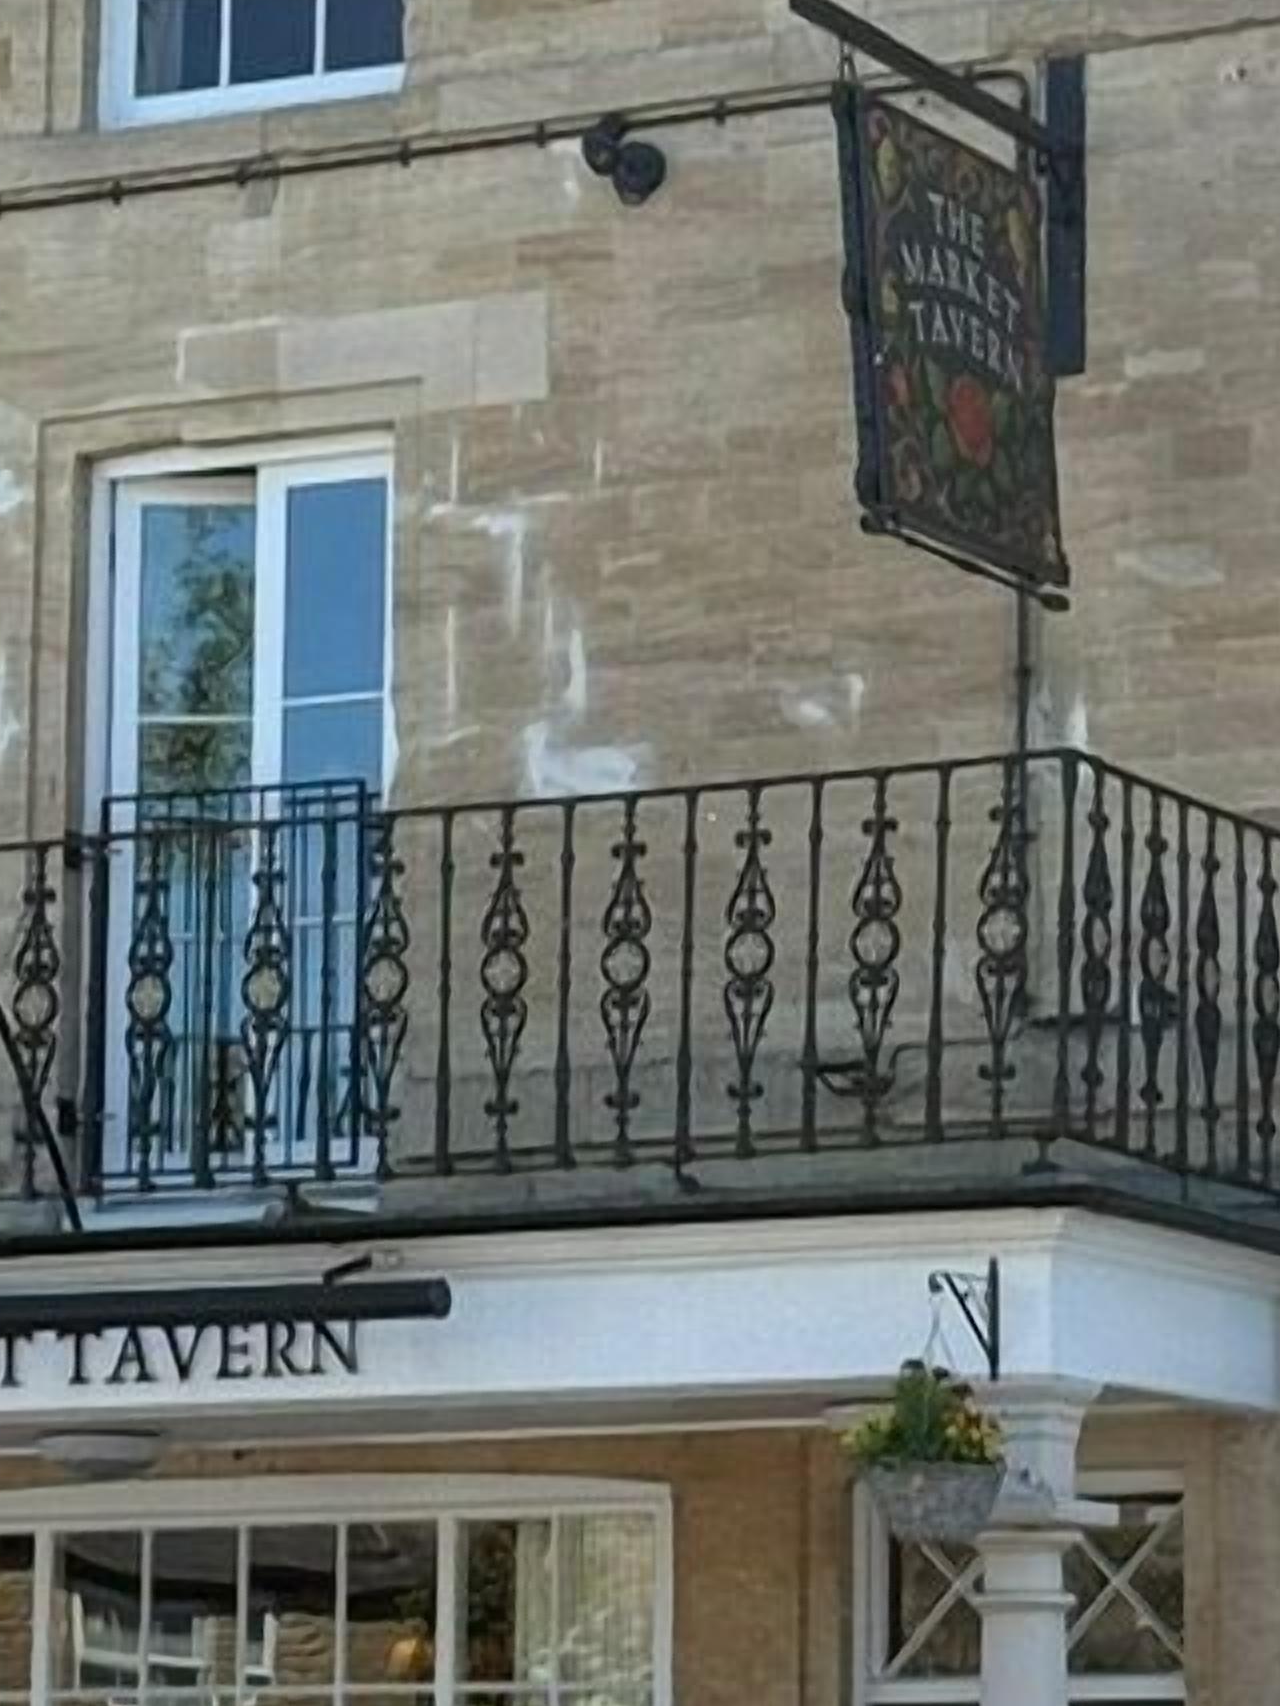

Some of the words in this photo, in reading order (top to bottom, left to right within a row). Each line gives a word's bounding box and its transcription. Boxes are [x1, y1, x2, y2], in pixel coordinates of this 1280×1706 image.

[927, 191, 985, 258] THE
[897, 239, 1021, 334] MARKET
[907, 300, 1022, 393] TAVERN
[56, 1317, 361, 1384] TAVERN
